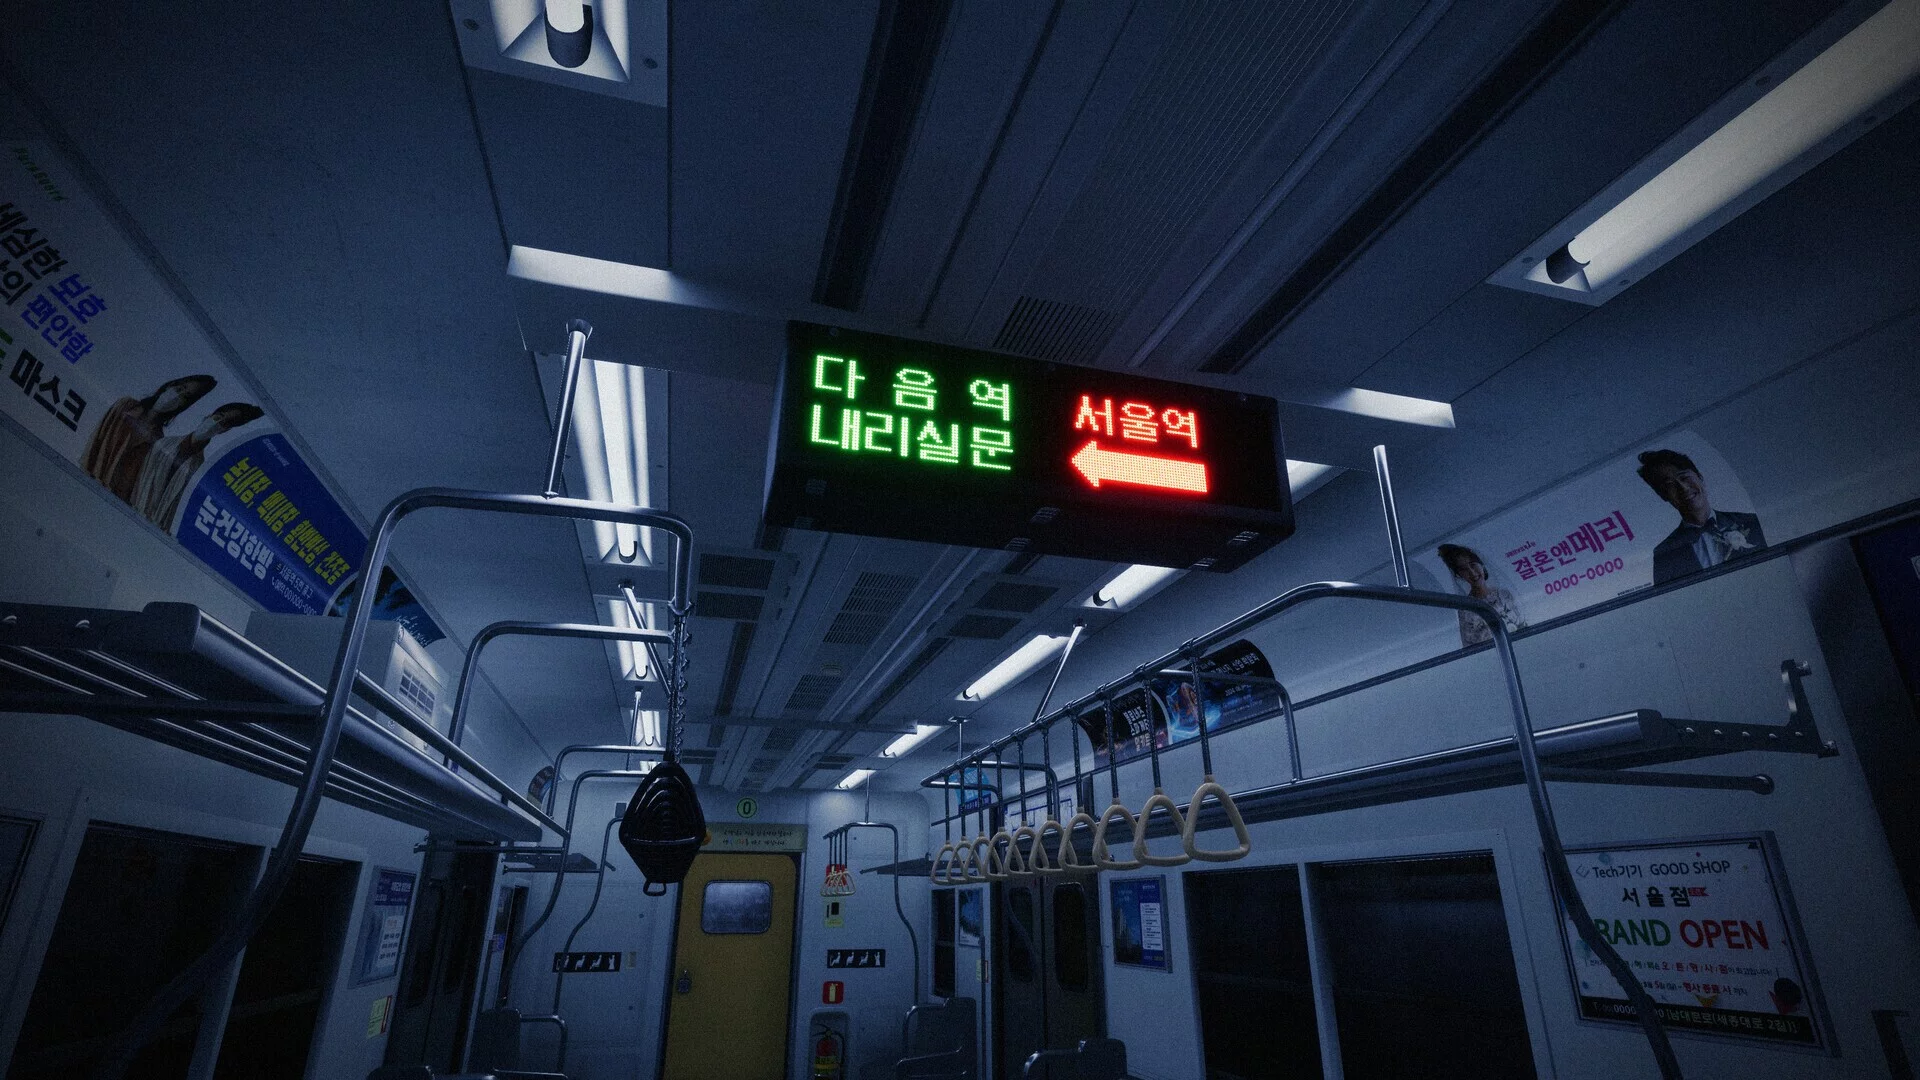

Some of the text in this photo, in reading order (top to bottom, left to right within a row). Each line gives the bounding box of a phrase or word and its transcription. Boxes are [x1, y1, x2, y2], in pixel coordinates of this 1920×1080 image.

[47, 273, 107, 324] 보호
[20, 294, 94, 364] 편안함
[9, 349, 87, 432] 마스크
[1074, 394, 1198, 449] 서울역
[1544, 557, 1624, 596] 0000-0000
[743, 801, 751, 815] 0
[1592, 860, 1731, 879] Tech기기 GOOD SHOP
[1592, 918, 1770, 950] RAND OPEN
